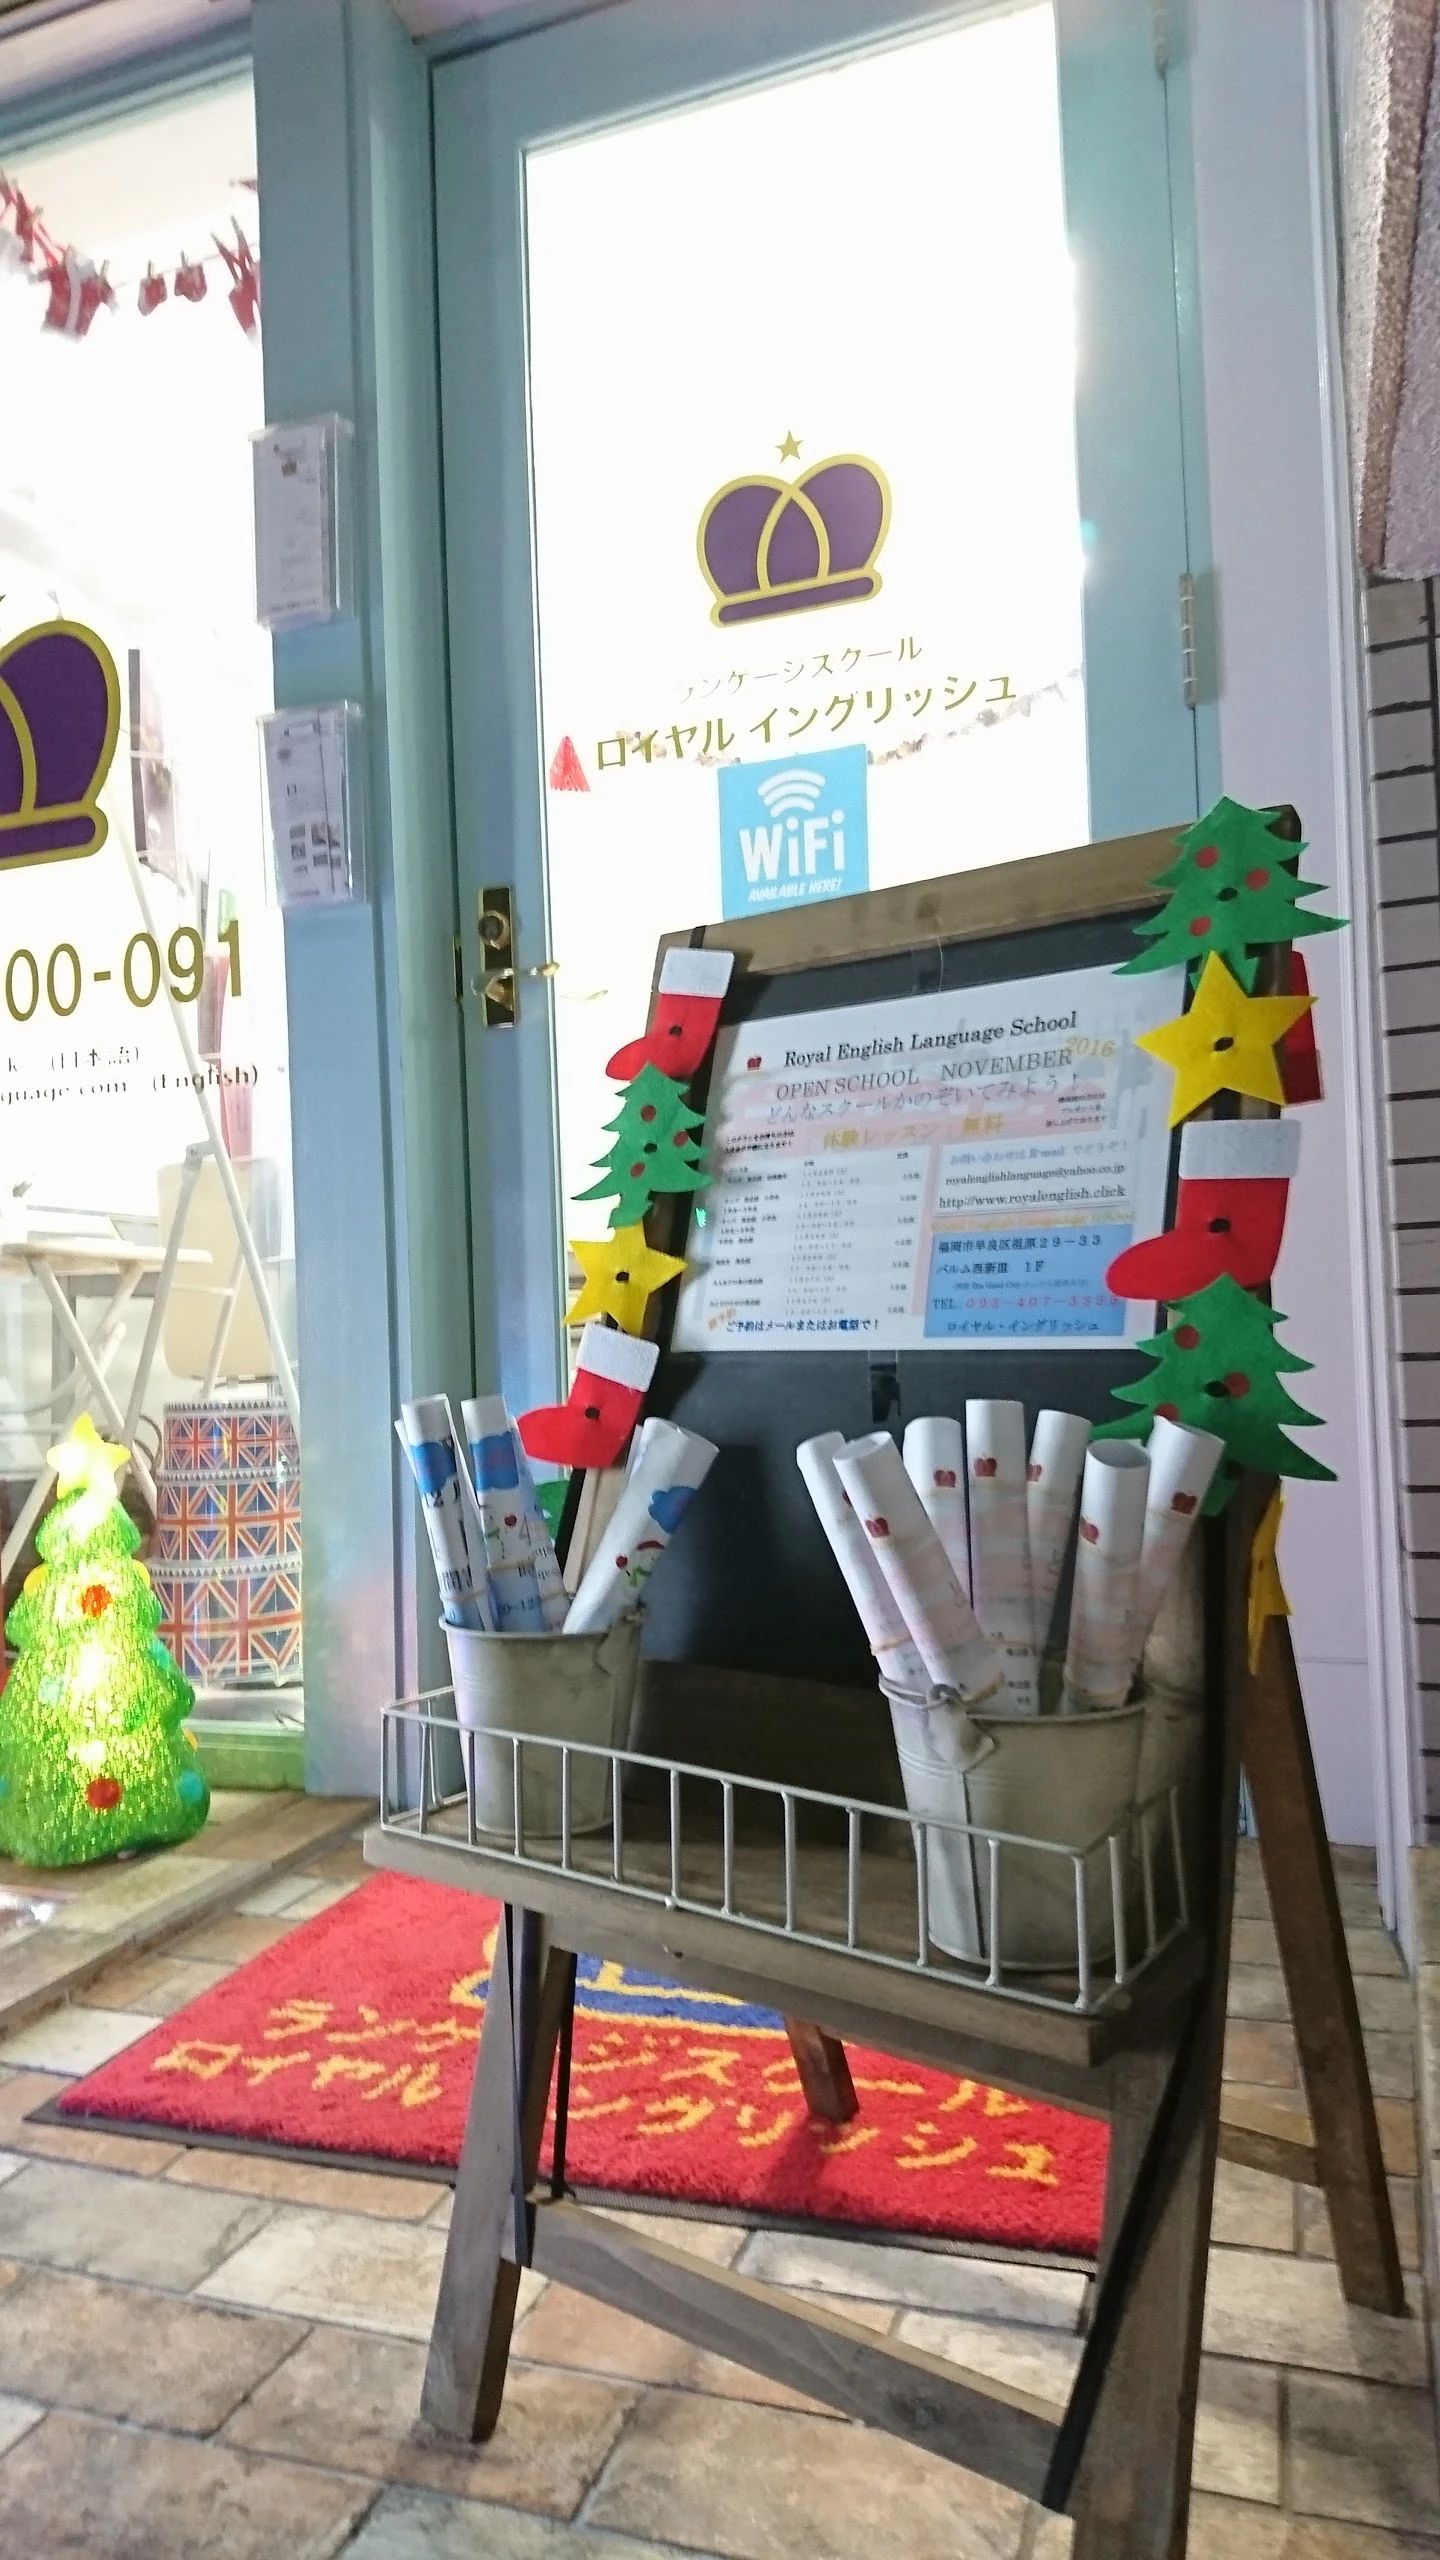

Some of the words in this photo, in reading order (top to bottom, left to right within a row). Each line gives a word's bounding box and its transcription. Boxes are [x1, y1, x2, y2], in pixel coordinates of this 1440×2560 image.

[738, 808, 846, 883] WiFi
[748, 881, 806, 903] AVAILABLE
[808, 877, 842, 895] HERE!
[776, 1079, 829, 1101] OPEN
[834, 1068, 919, 1094] SCHOOL
[940, 1048, 1073, 1081] NOVEMBER
[1066, 1036, 1115, 1057] 2016
[784, 1043, 832, 1068] Royal
[837, 1036, 904, 1061] English
[910, 1023, 1004, 1048] Language
[1010, 1010, 1079, 1037] School
